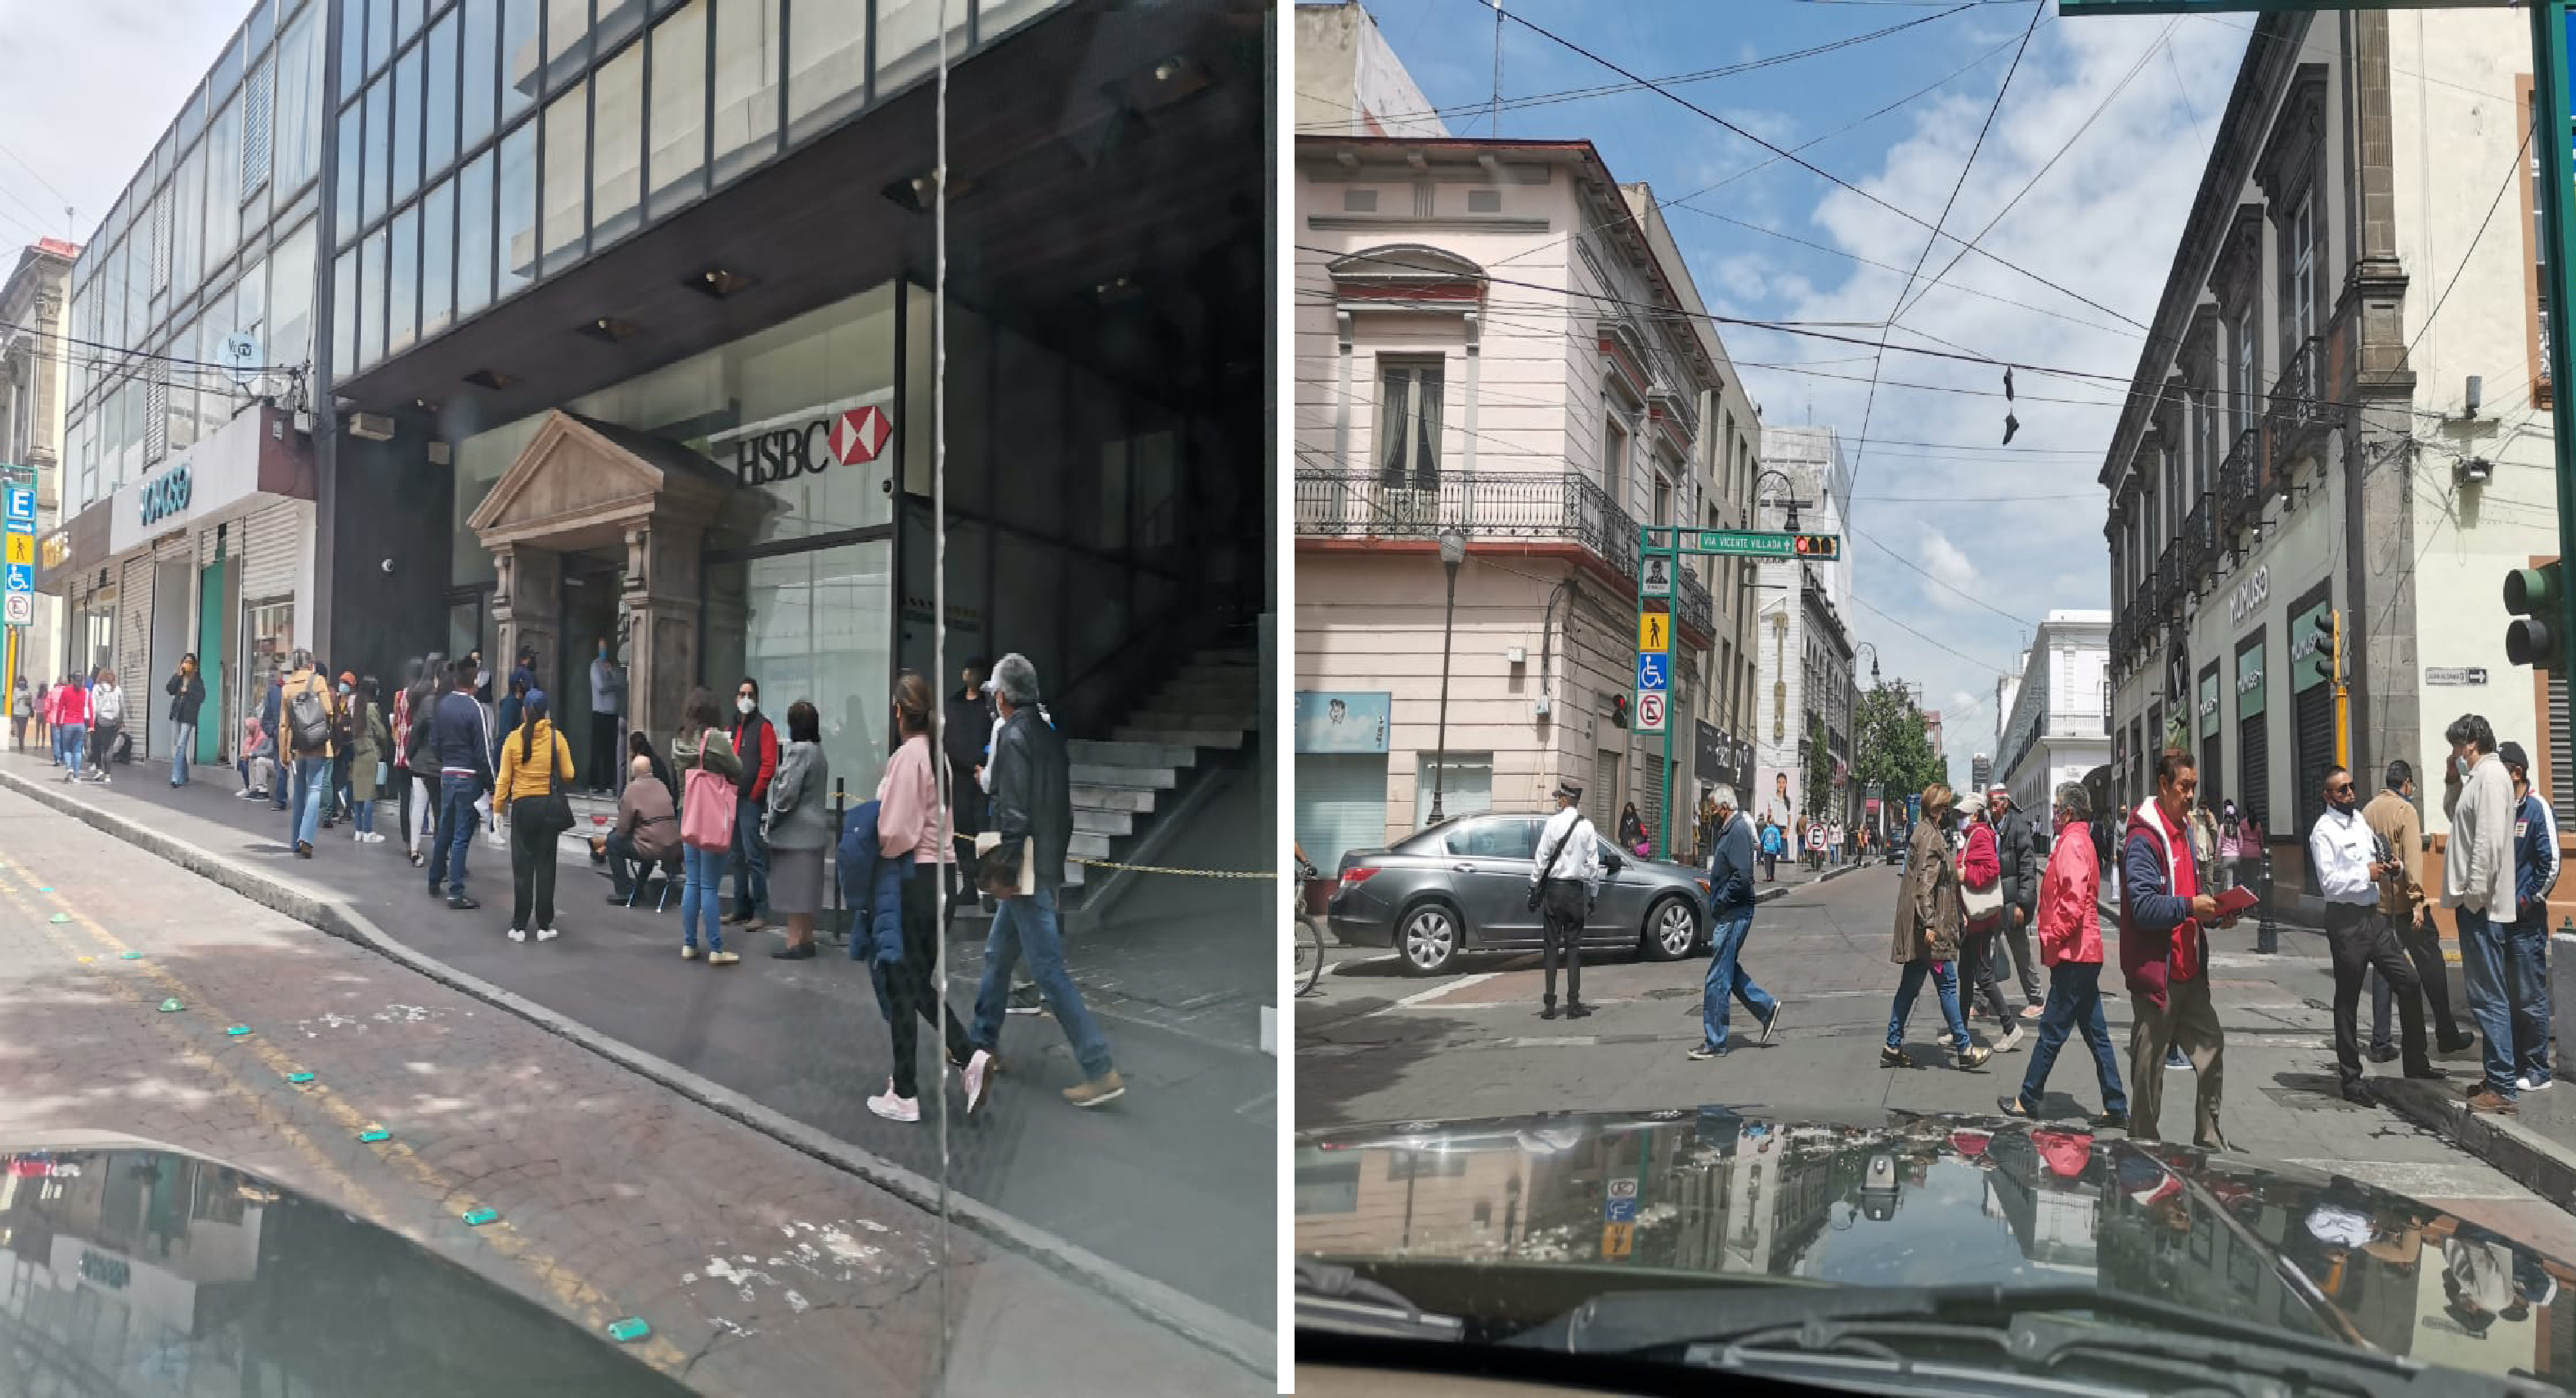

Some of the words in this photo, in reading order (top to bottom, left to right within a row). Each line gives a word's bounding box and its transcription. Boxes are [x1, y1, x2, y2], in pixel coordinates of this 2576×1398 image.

[736, 420, 830, 486] HSBC
[13, 491, 29, 516] E
[1703, 535, 1716, 546] VIA
[1720, 535, 1748, 549] VICENTE
[1751, 538, 1782, 550] VILLADA
[2230, 565, 2267, 624] MUMUSO
[1646, 700, 1658, 719] E
[1813, 829, 1821, 845] E
